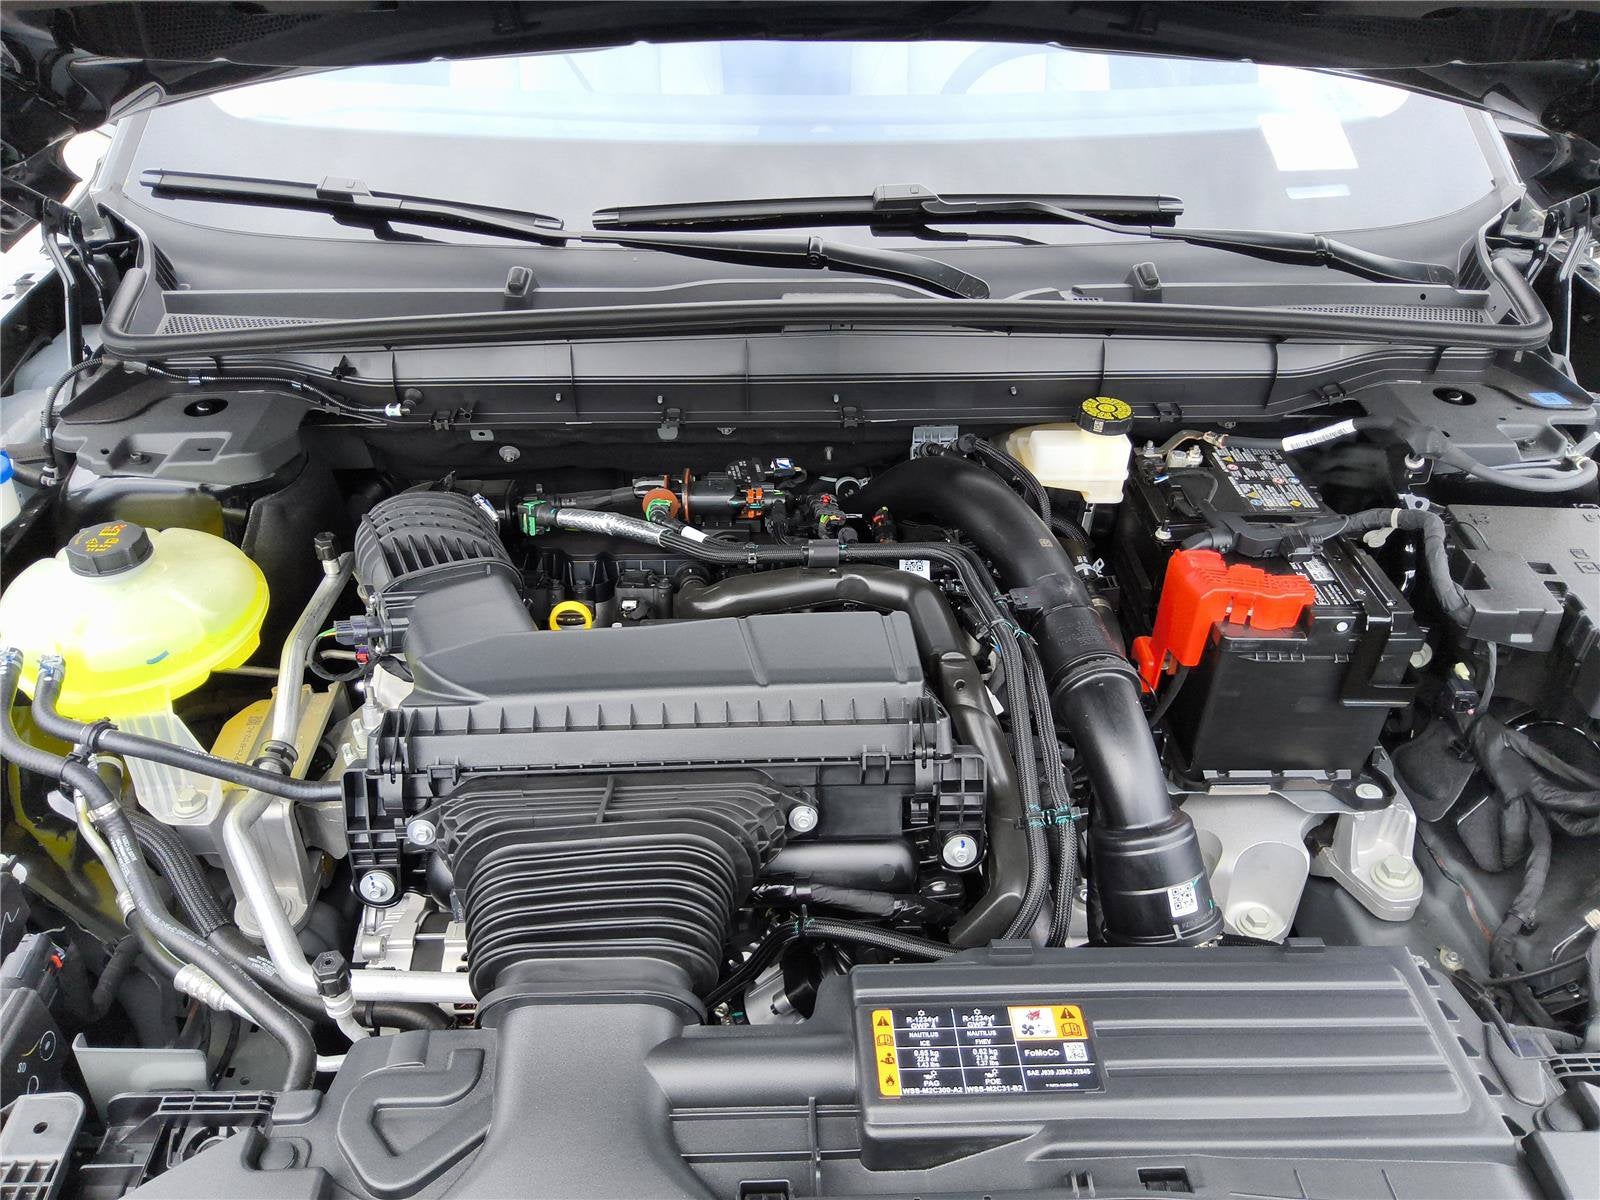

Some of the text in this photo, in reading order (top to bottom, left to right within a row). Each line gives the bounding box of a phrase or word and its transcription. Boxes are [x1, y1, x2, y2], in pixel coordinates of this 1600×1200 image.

[906, 1016, 939, 1024] R-1234yf
[962, 1015, 995, 1023] R-1234yf
[929, 1049, 940, 1057] kg
[988, 1048, 999, 1056] kg
[1024, 1048, 1060, 1057] FoMoCo
